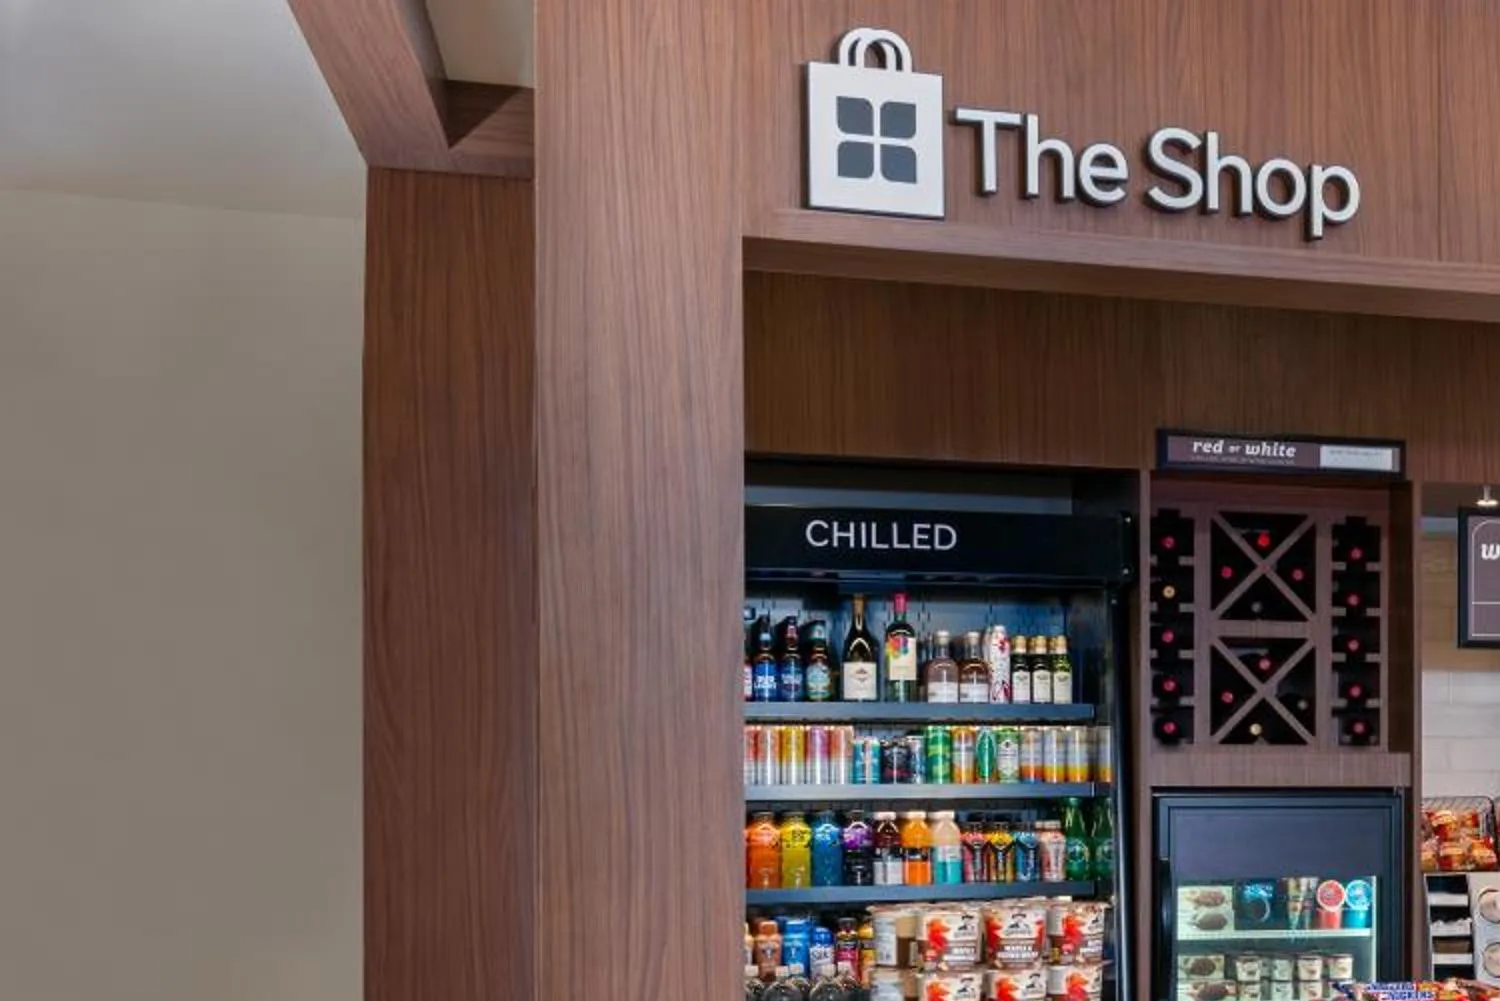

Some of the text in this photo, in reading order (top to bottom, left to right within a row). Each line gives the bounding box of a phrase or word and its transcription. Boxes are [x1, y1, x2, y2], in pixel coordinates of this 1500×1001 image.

[954, 106, 1361, 241] The Shop
[1192, 439, 1297, 458] red or white
[804, 519, 957, 551] CHILLED
